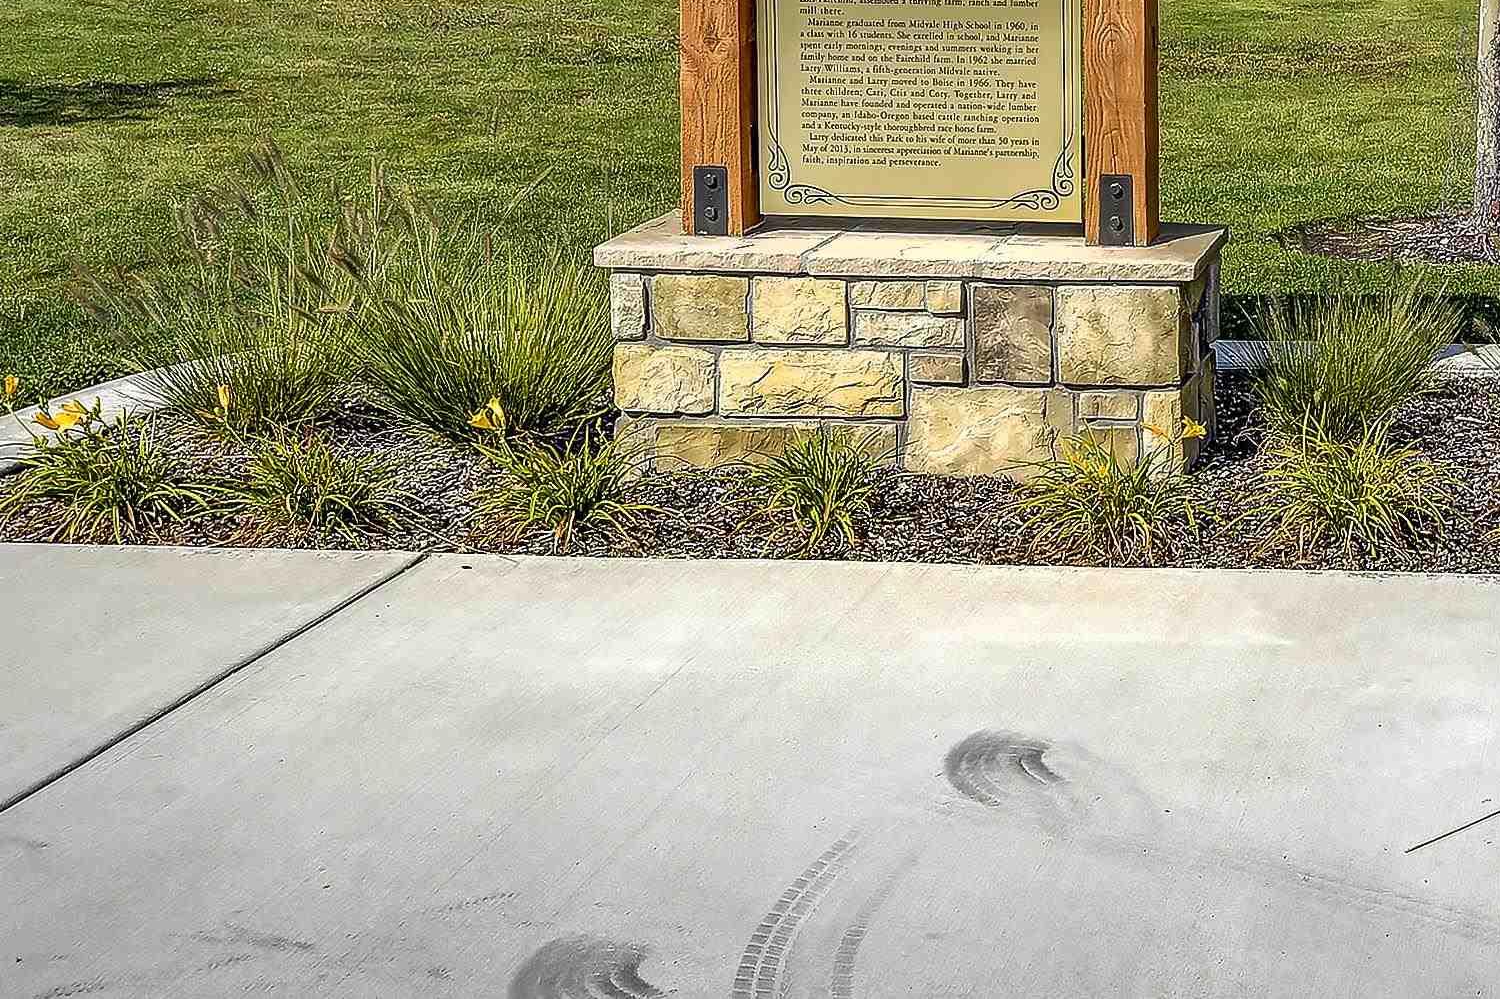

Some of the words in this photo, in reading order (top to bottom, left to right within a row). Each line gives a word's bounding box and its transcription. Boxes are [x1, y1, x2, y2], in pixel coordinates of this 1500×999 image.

[800, 5, 816, 14] mill
[820, 6, 844, 15] there.
[807, 17, 844, 26] Marianne
[846, 17, 884, 29] graduated
[887, 18, 906, 27] from
[908, 19, 940, 28] Midvale
[942, 19, 963, 31] High
[965, 20, 991, 29] School
[1005, 21, 1028, 31] 1960,
[806, 28, 824, 37] class
[827, 29, 844, 38] with
[848, 29, 857, 38] 16
[913, 30, 943, 40] excelled
[957, 31, 984, 42] school,
[1001, 32, 1039, 42] Marianne
[800, 41, 821, 51] spent
[823, 40, 842, 52] early
[845, 41, 885, 53] mornings,
[887, 42, 922, 53] evenings
[979, 44, 1012, 55] working
[1026, 45, 1039, 53] her
[800, 51, 825, 63] family
[827, 52, 849, 61] home
[896, 53, 930, 63] Fairchild
[968, 55, 987, 64] 1962
[1005, 55, 1036, 65] married
[800, 63, 822, 74] Larry
[824, 63, 863, 74] Williams,
[872, 64, 935, 77] fifth-generation
[938, 66, 970, 75] Midvale
[809, 74, 846, 84] Marianne
[867, 76, 887, 87] Larry
[891, 76, 917, 85] moved
[932, 77, 953, 86] Boise
[969, 78, 991, 87] 1966.
[996, 78, 1014, 90] They
[1018, 79, 1037, 88] have
[801, 86, 824, 95] three
[954, 89, 992, 101] Together,
[996, 90, 1018, 101] Larry
[801, 97, 837, 107] Marianne
[840, 98, 858, 107] have
[861, 98, 893, 108] founded
[912, 99, 947, 111] operated
[957, 100, 1005, 110] nation-wide
[1008, 102, 1036, 111] lumber
[801, 111, 838, 121] company,
[854, 110, 909, 122] Idaho-Oregon
[912, 111, 934, 120] based
[937, 112, 960, 121] cattle
[963, 112, 998, 124] ranching
[1001, 113, 1039, 125] operation
[824, 121, 881, 133] Kentucky-style
[883, 122, 935, 134] thoroughbred
[809, 132, 829, 143] Larry
[831, 132, 866, 141] dedicated
[869, 133, 883, 142] this
[886, 133, 904, 142] Park
[915, 134, 927, 143] his
[929, 134, 946, 143] wife
[978, 135, 995, 144] than
[998, 136, 1008, 144] 50
[1010, 138, 1029, 147] years
[802, 143, 818, 155] May
[895, 145, 941, 157] appreciation
[953, 146, 993, 156] Marianne's
[802, 155, 824, 165] faith,
[826, 155, 870, 167] inspiration
[888, 159, 941, 168] perseverance.
